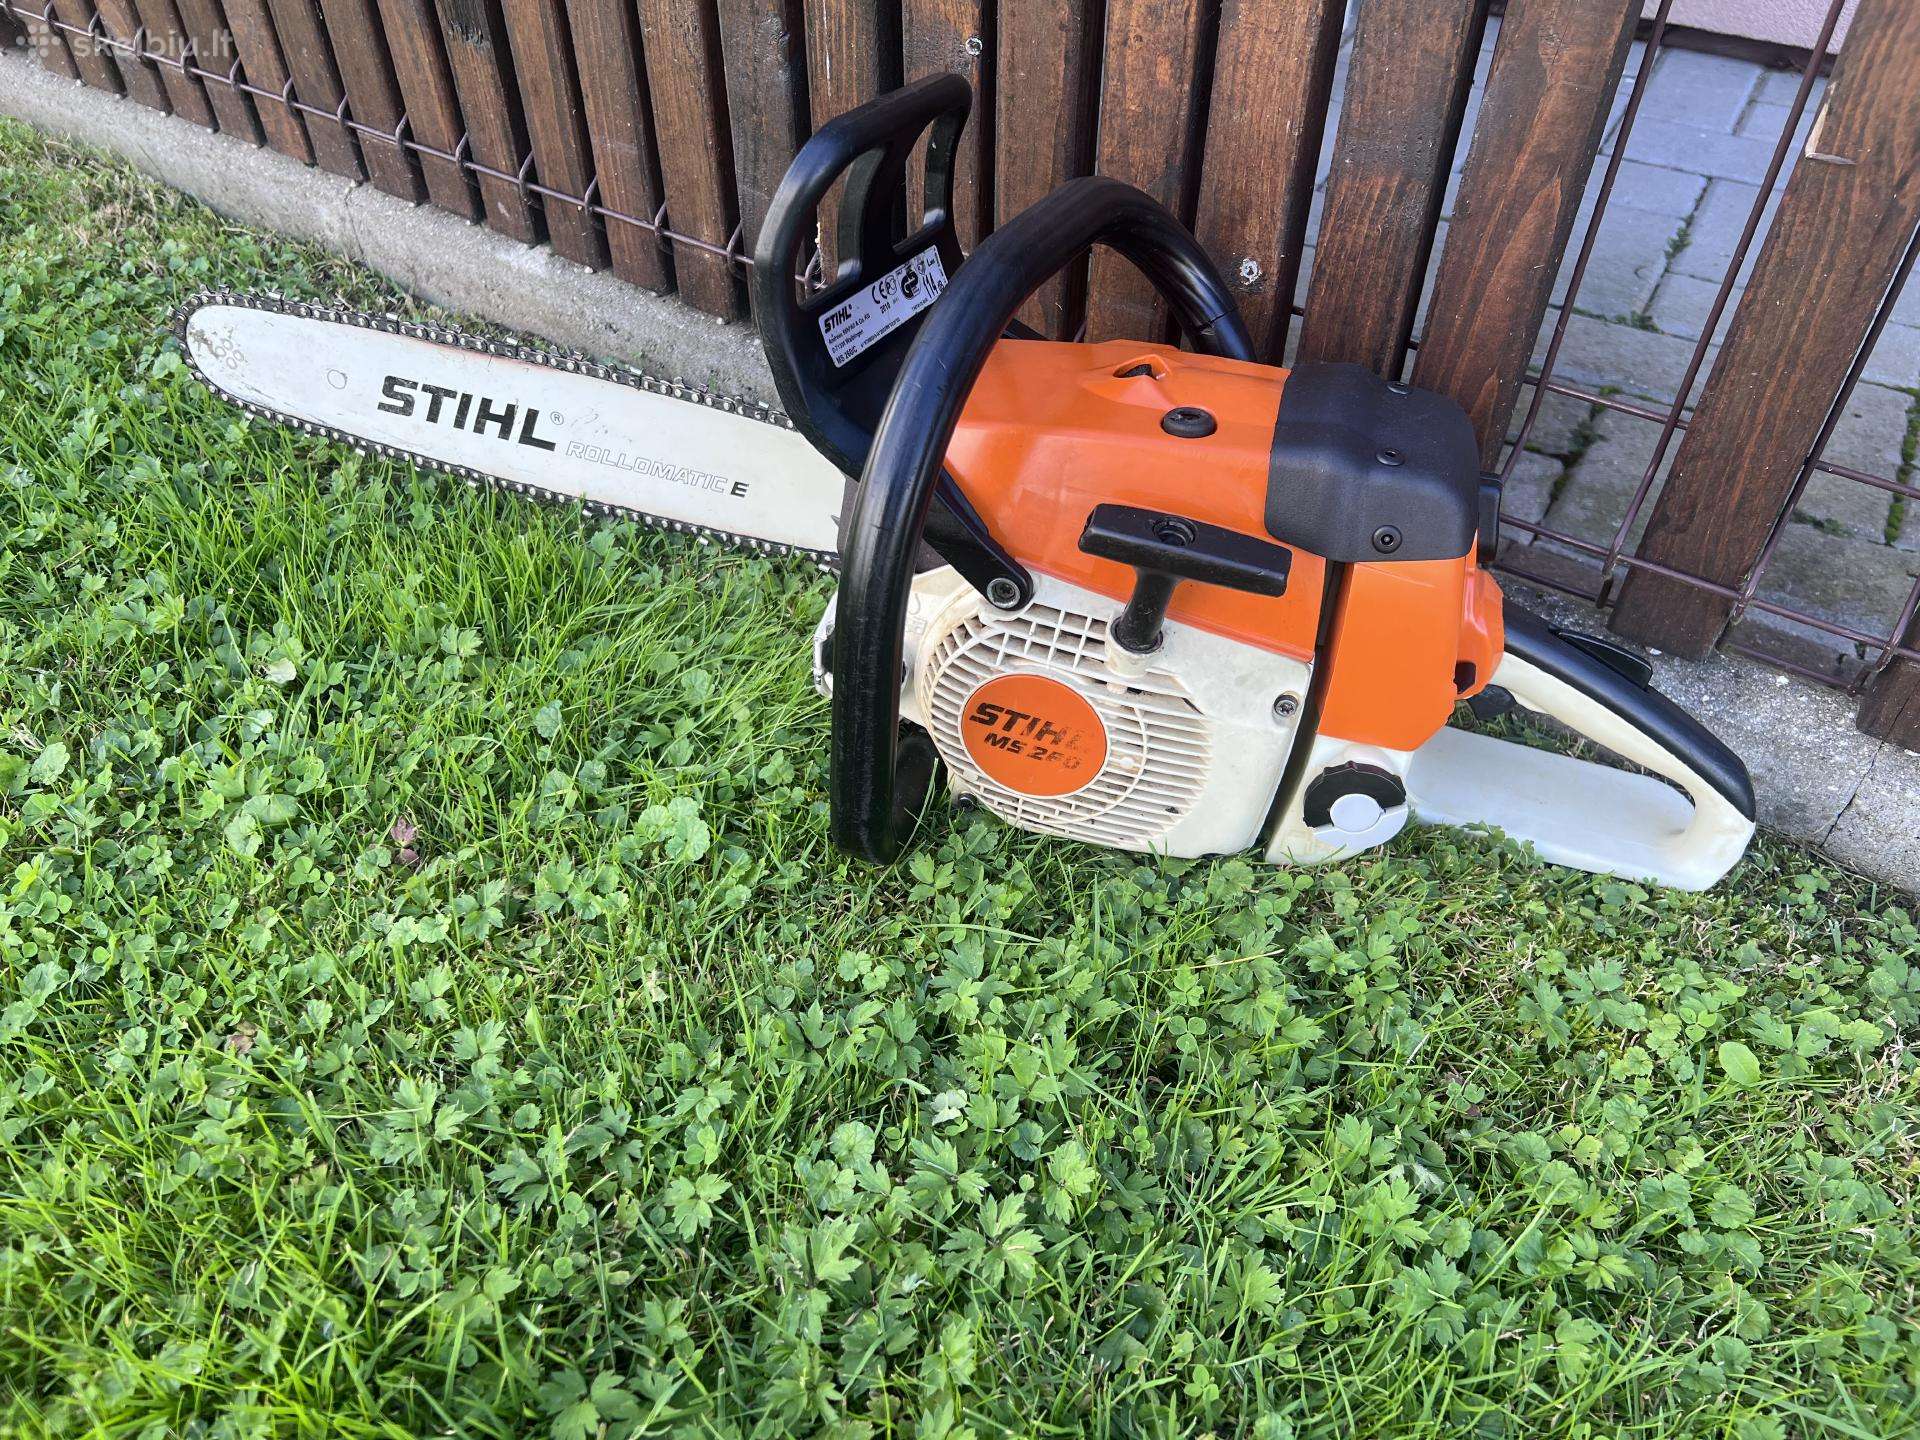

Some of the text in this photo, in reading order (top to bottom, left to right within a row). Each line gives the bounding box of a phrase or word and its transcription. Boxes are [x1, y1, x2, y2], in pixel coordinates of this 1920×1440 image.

[824, 305, 852, 333] STIHL
[836, 353, 845, 364] MS
[378, 375, 557, 452] STIHL
[566, 440, 750, 498] ROLLOMATIC E
[984, 733, 1027, 755] MS
